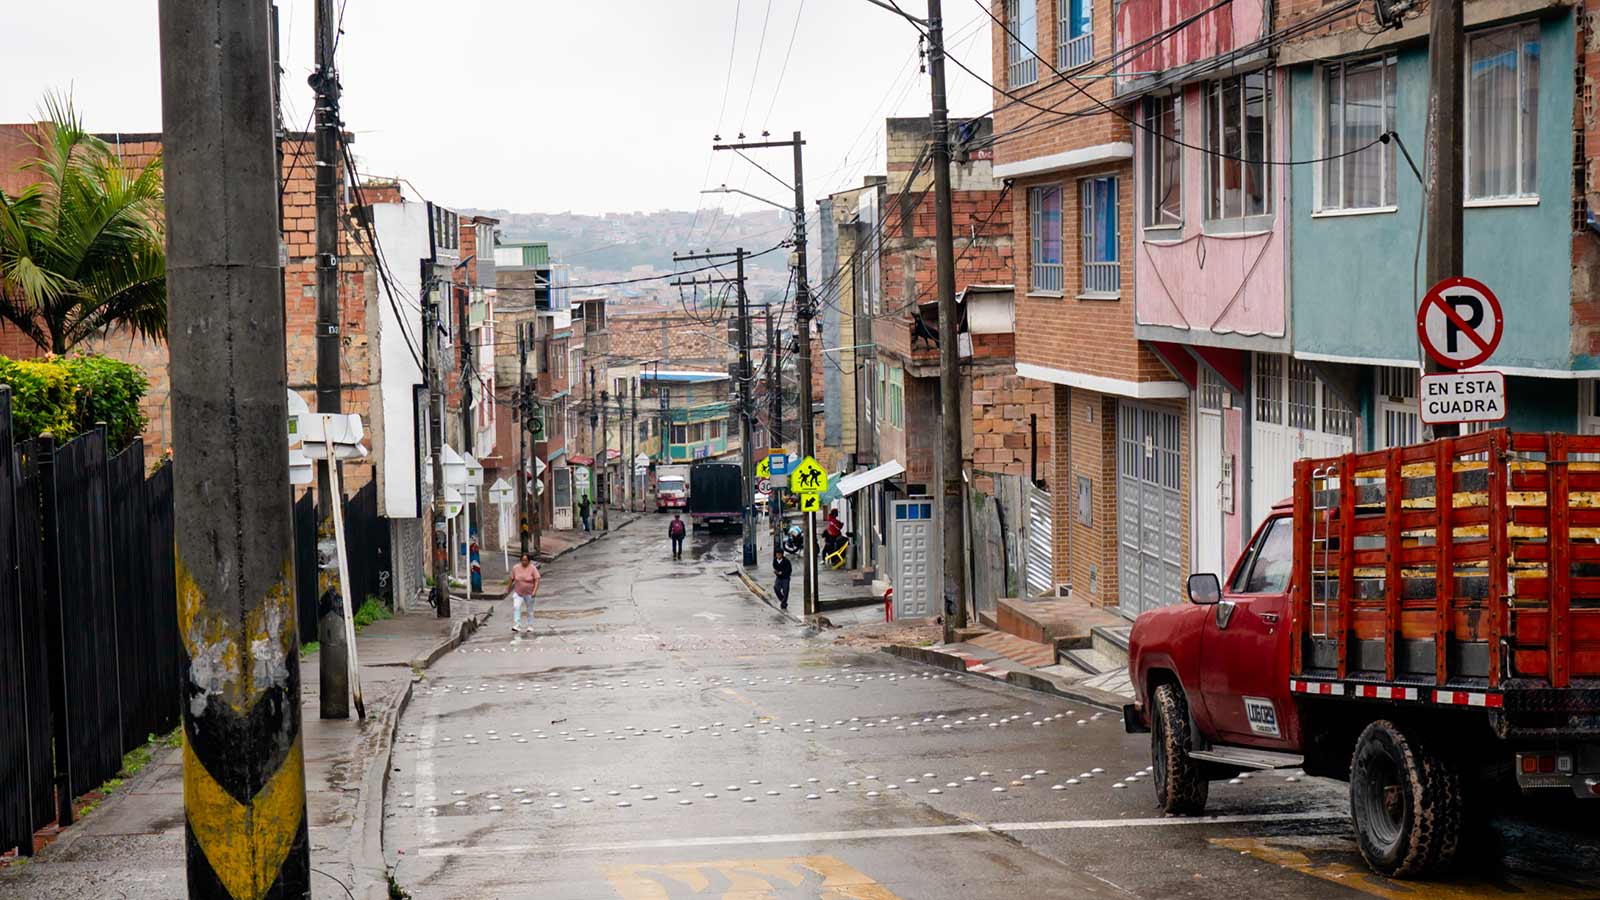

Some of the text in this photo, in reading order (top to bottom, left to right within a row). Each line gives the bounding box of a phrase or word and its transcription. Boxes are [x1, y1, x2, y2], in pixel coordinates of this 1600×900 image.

[1445, 295, 1484, 353] P
[1428, 380, 1496, 396] EN ESTA
[1429, 399, 1498, 415] CUADRA
